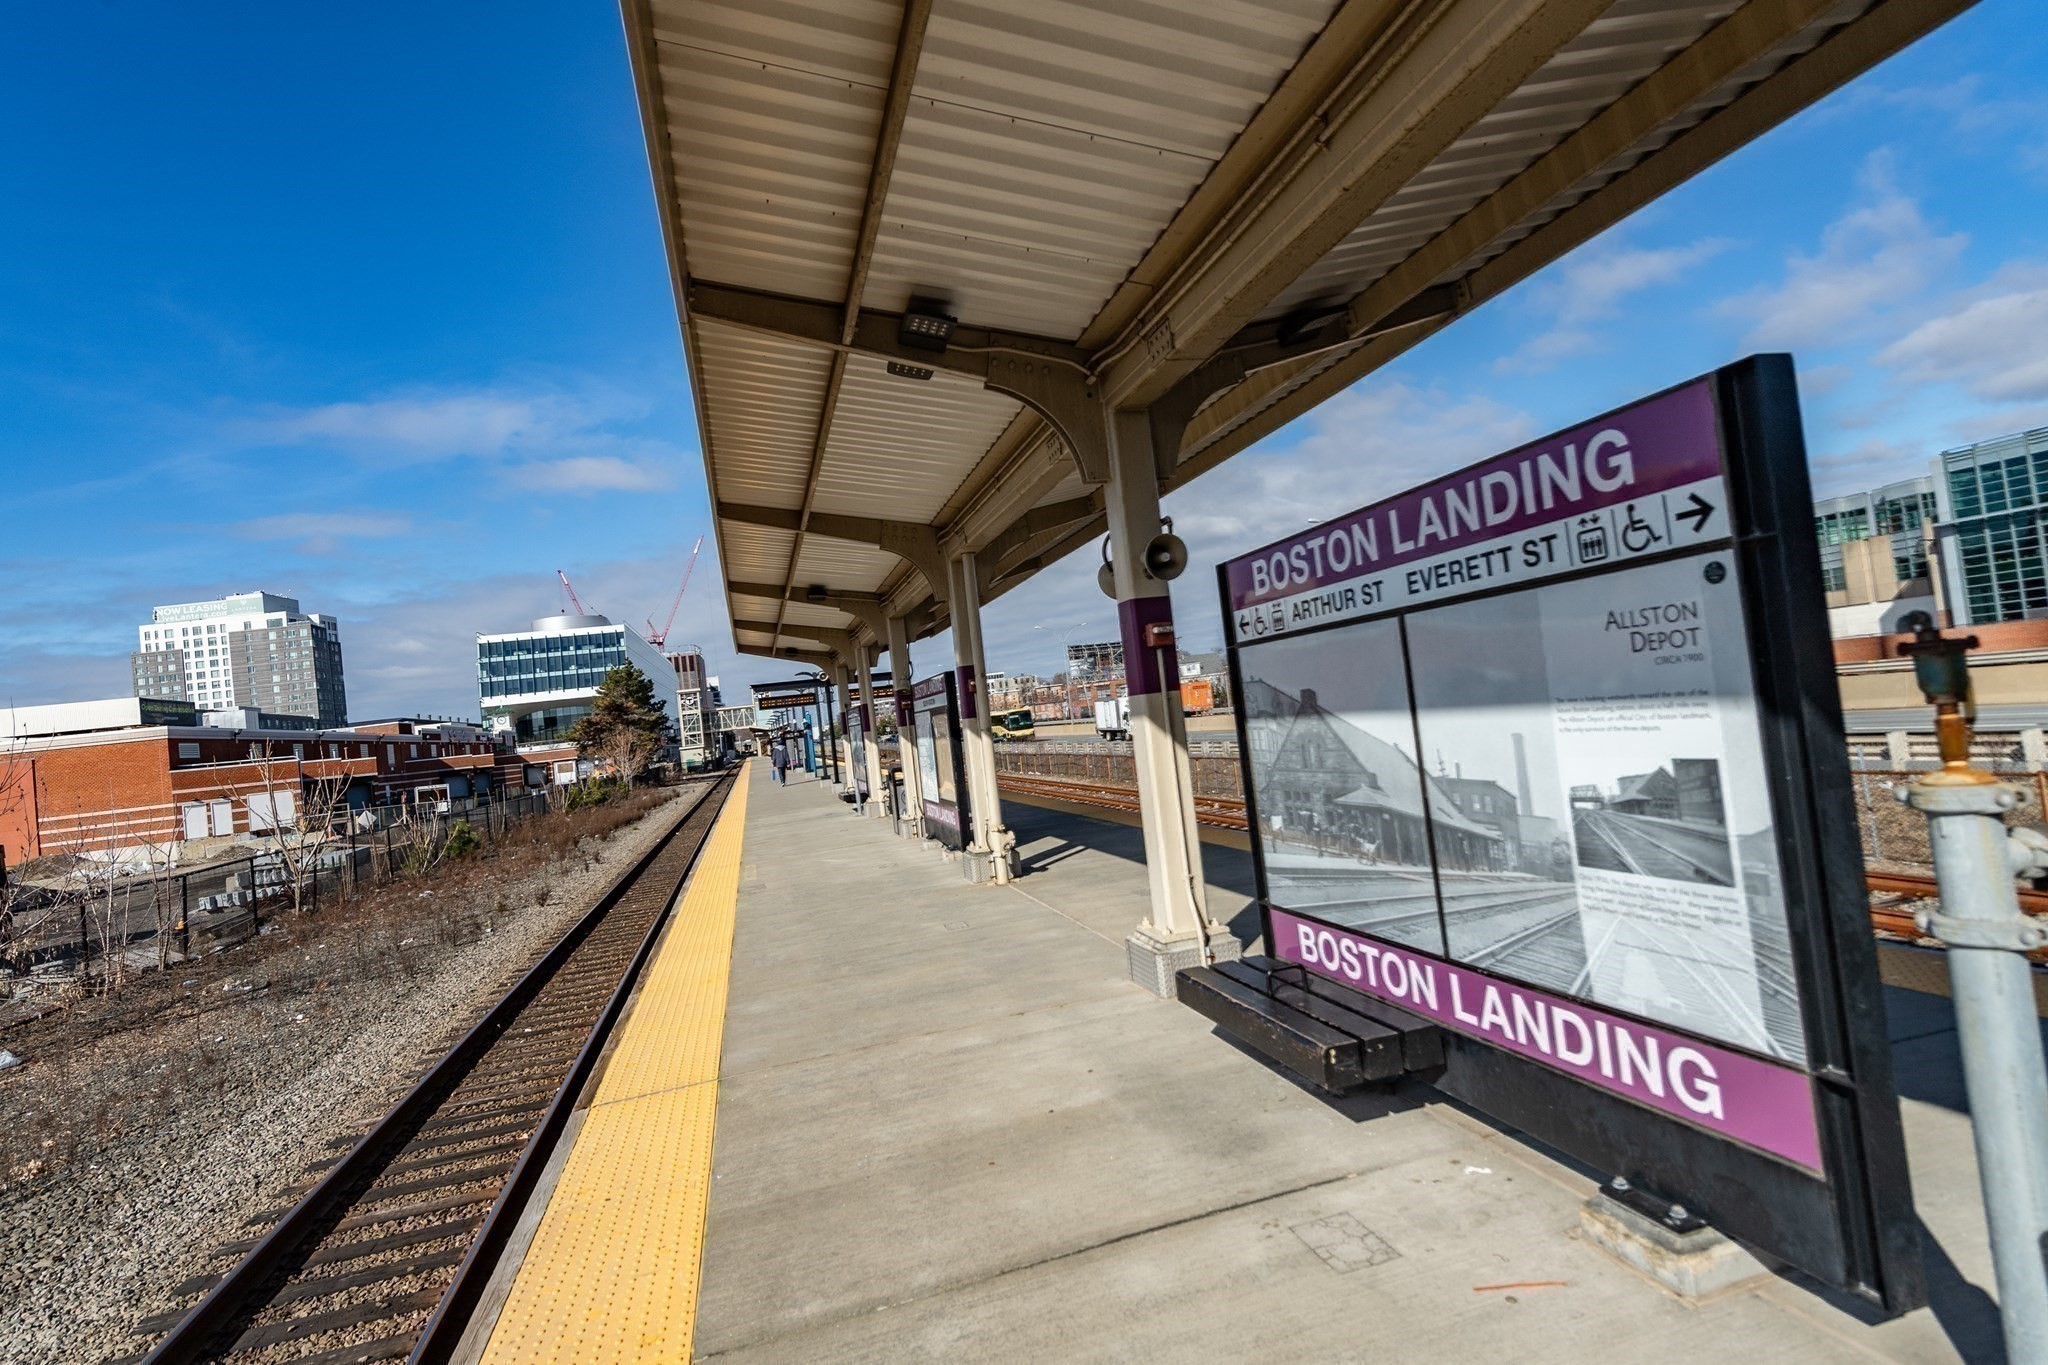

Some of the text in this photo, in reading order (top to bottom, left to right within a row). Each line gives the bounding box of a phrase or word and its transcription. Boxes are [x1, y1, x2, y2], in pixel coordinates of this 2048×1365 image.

[1252, 429, 1634, 596] BOSTON LANDING
[1407, 535, 1558, 595] EVERETT ST
[157, 602, 227, 616] NOW LEASING
[1291, 580, 1384, 622] ARTHUR ST
[1604, 601, 1698, 631] ALLSTON
[1630, 627, 1700, 652] DEPOT
[1654, 656, 1682, 665] CIRCA
[1297, 923, 1724, 1120] BOSTON LANDING
